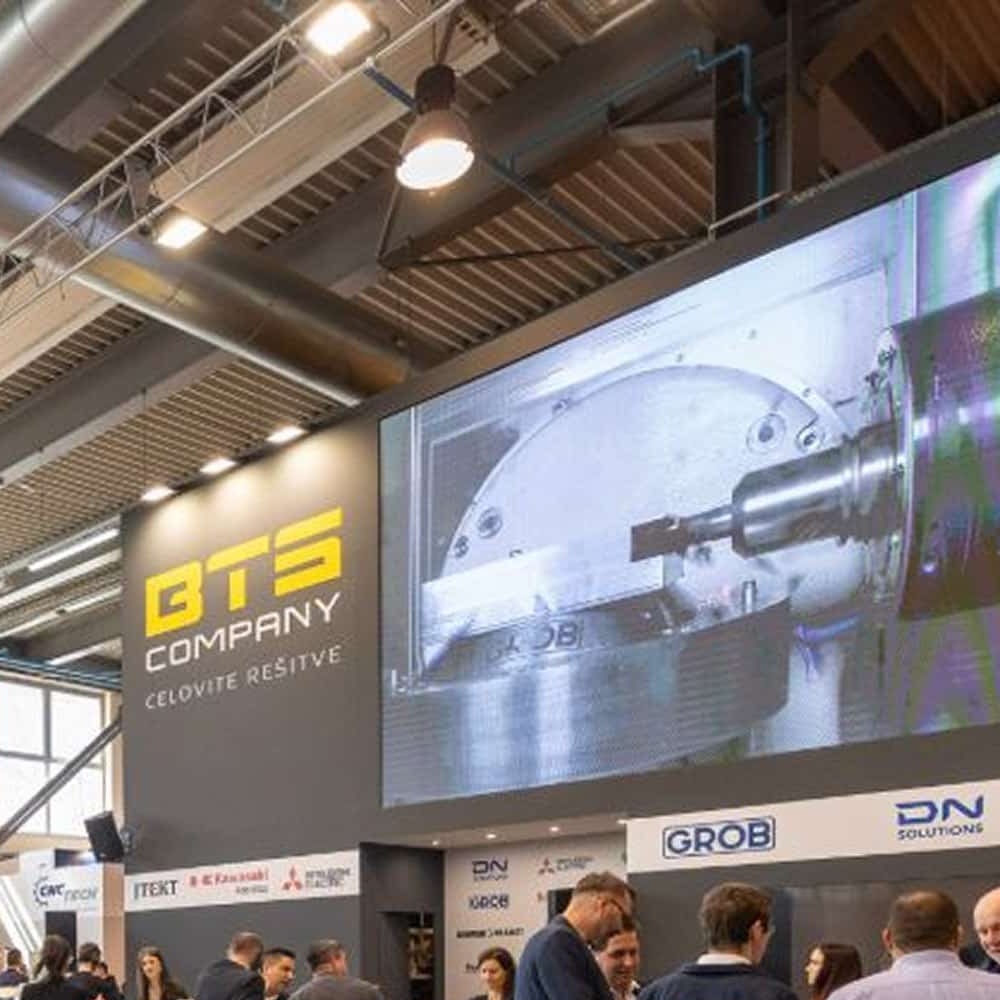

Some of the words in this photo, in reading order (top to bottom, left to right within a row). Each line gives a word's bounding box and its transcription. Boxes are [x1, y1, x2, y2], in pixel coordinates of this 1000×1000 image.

[145, 506, 342, 638] BTS
[146, 591, 341, 673] COMPANY
[145, 672, 238, 709] CELOVITE
[248, 644, 342, 686] REŠITVE
[896, 796, 984, 826] DN
[897, 823, 984, 841] SOLUTIONS
[666, 820, 772, 855] GROB
